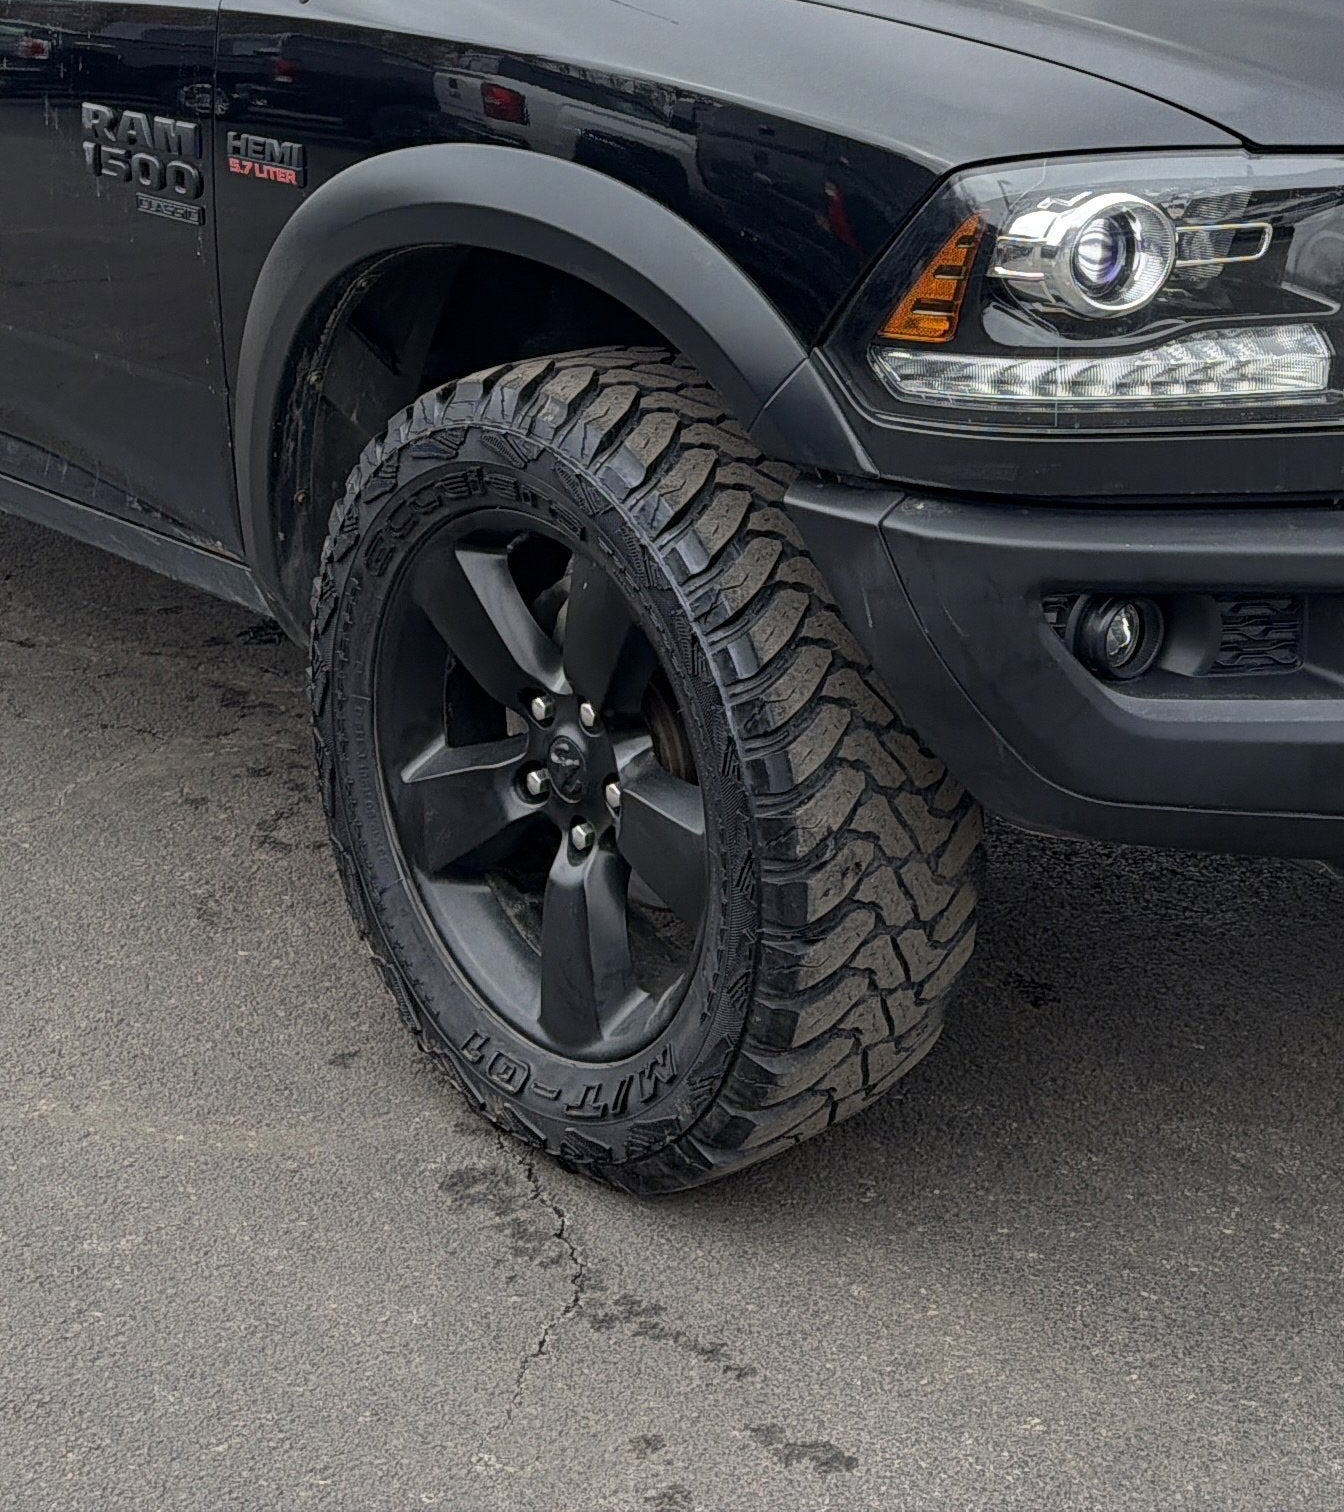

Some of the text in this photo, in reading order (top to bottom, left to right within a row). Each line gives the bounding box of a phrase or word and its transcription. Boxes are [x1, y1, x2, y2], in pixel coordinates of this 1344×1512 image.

[81, 101, 203, 159] RAM
[226, 131, 306, 170] HEMI
[82, 141, 205, 200] 1500
[228, 157, 298, 185] 5.7 LITER
